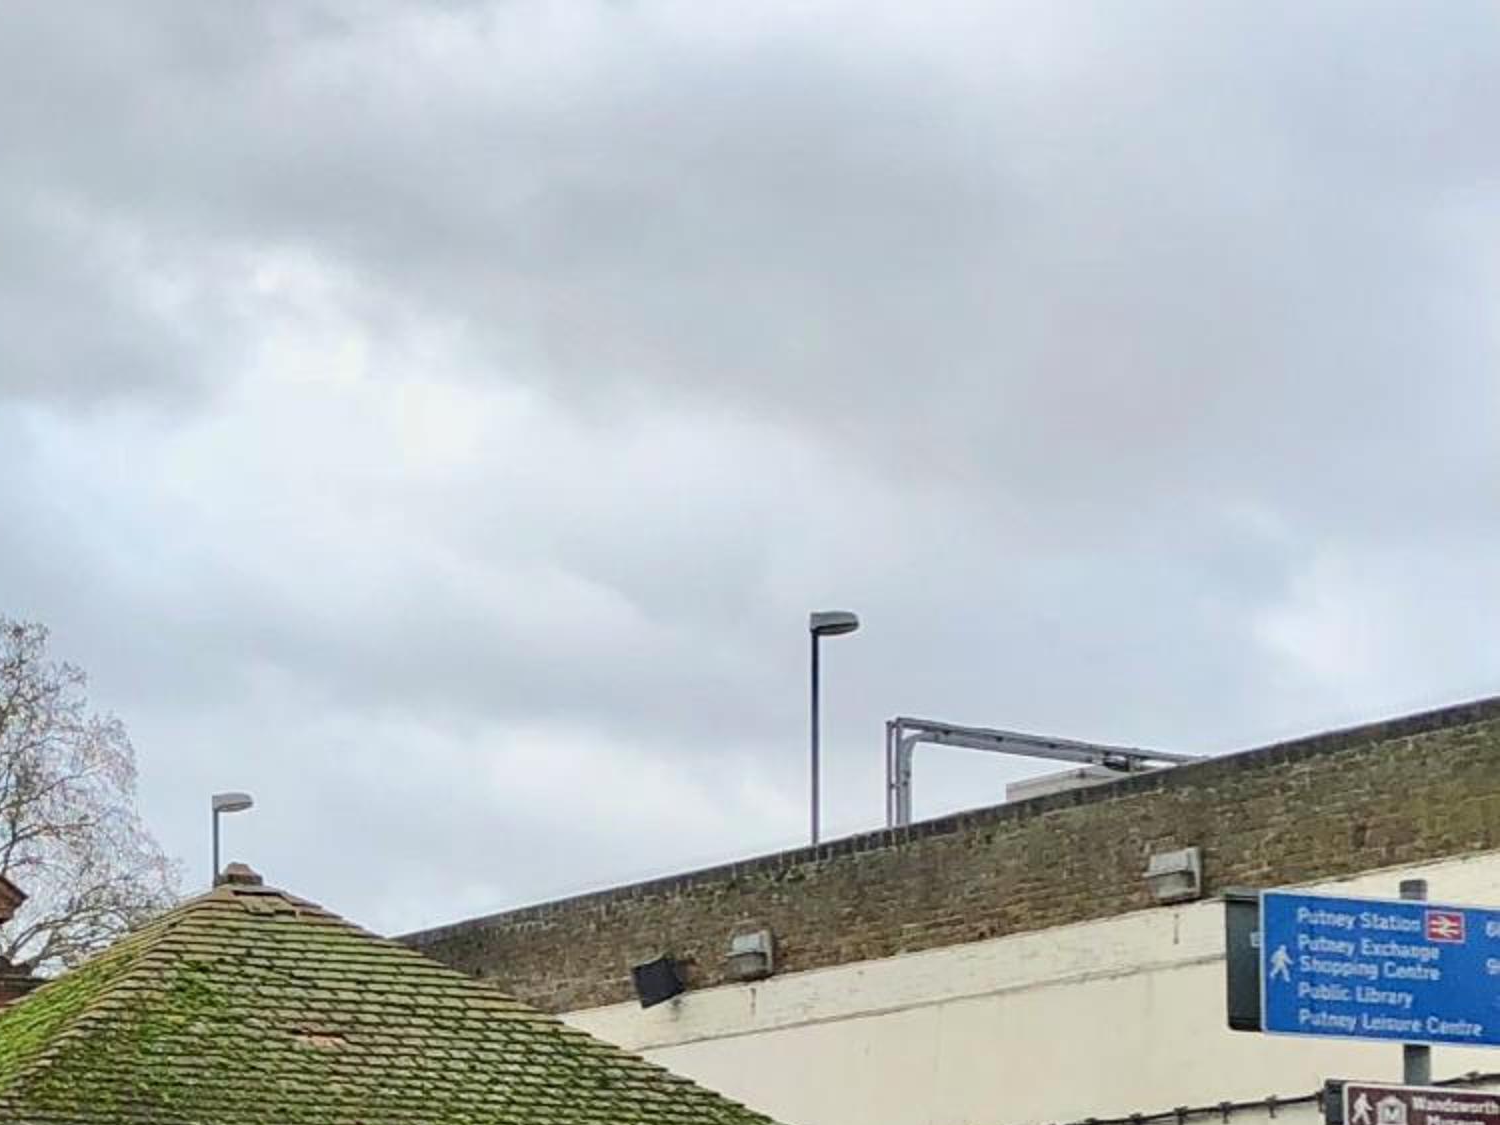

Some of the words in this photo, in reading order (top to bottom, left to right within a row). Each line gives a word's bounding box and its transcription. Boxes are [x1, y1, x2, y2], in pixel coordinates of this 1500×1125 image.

[1297, 906, 1356, 930] Putney
[1360, 911, 1421, 932] Station
[1297, 933, 1357, 957] Putney
[1361, 937, 1440, 962] Exchange
[1300, 955, 1380, 981] Shopping
[1383, 961, 1442, 982] Centre
[1297, 981, 1350, 1001] Public
[1355, 985, 1414, 1009] Library
[1299, 1008, 1357, 1031] Putney
[1362, 1013, 1423, 1034] Leisure
[1426, 1016, 1483, 1038] Centre
